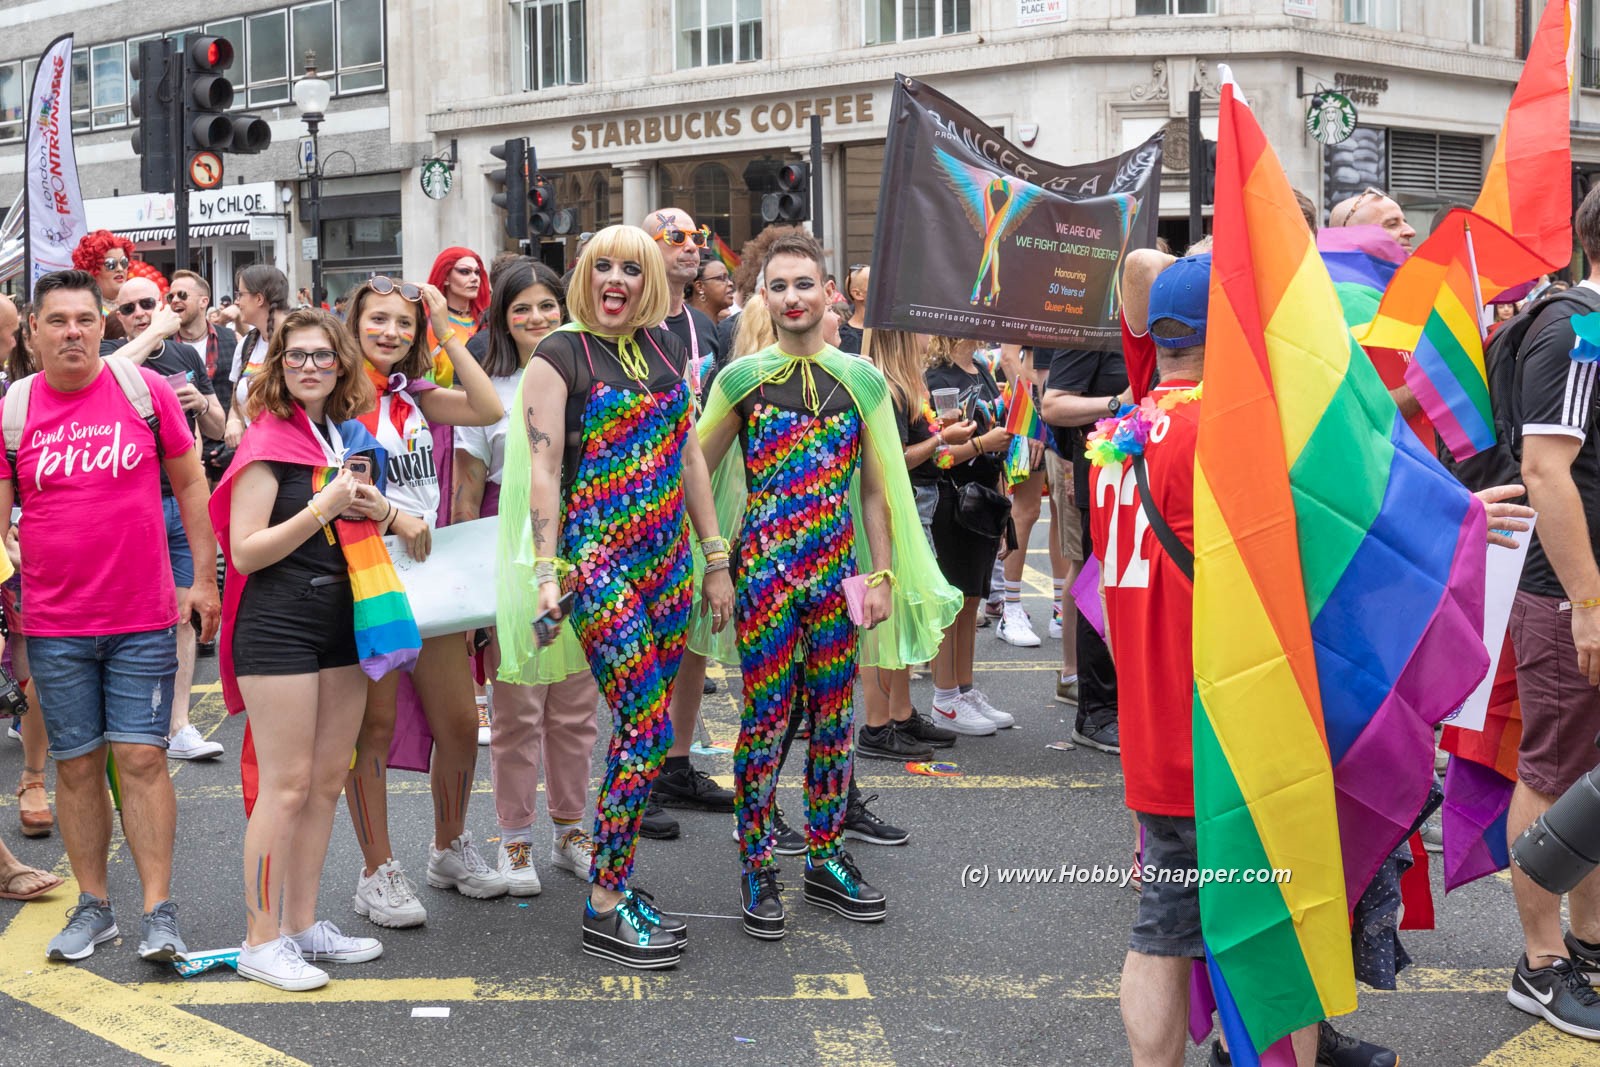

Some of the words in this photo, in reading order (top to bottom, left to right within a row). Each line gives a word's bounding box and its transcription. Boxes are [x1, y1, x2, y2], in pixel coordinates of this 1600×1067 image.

[1021, 3, 1046, 15] PLACE
[1047, 1, 1060, 12] W1
[1334, 72, 1389, 92] STARBUCKS
[1344, 91, 1379, 107] OFFEE
[571, 107, 741, 151] STARBUCKS
[750, 93, 874, 133] COFFEE
[39, 145, 54, 210] London
[1079, 175, 1102, 194] A
[199, 199, 214, 219] by
[217, 194, 267, 214] CHLOE.
[1055, 222, 1068, 235] WE
[1069, 225, 1086, 237] ARE
[1086, 227, 1103, 240] ONE
[1015, 235, 1033, 248] WE
[1033, 238, 1058, 251] FIGHT
[1059, 242, 1091, 257] CANCER
[1054, 267, 1087, 283] Honouring
[1048, 283, 1060, 294] 50
[1060, 285, 1077, 297] Years
[1078, 287, 1086, 297] of
[1044, 301, 1065, 312] Queer
[1065, 303, 1084, 314] Revolt
[909, 309, 996, 328] cancerisadrag.org
[1001, 320, 1028, 330] twitter
[1029, 324, 1080, 337] @cancer_isadrag
[32, 425, 65, 448] Civil
[68, 422, 113, 441] Service
[35, 421, 143, 491] pride
[1096, 458, 1151, 588] 22
